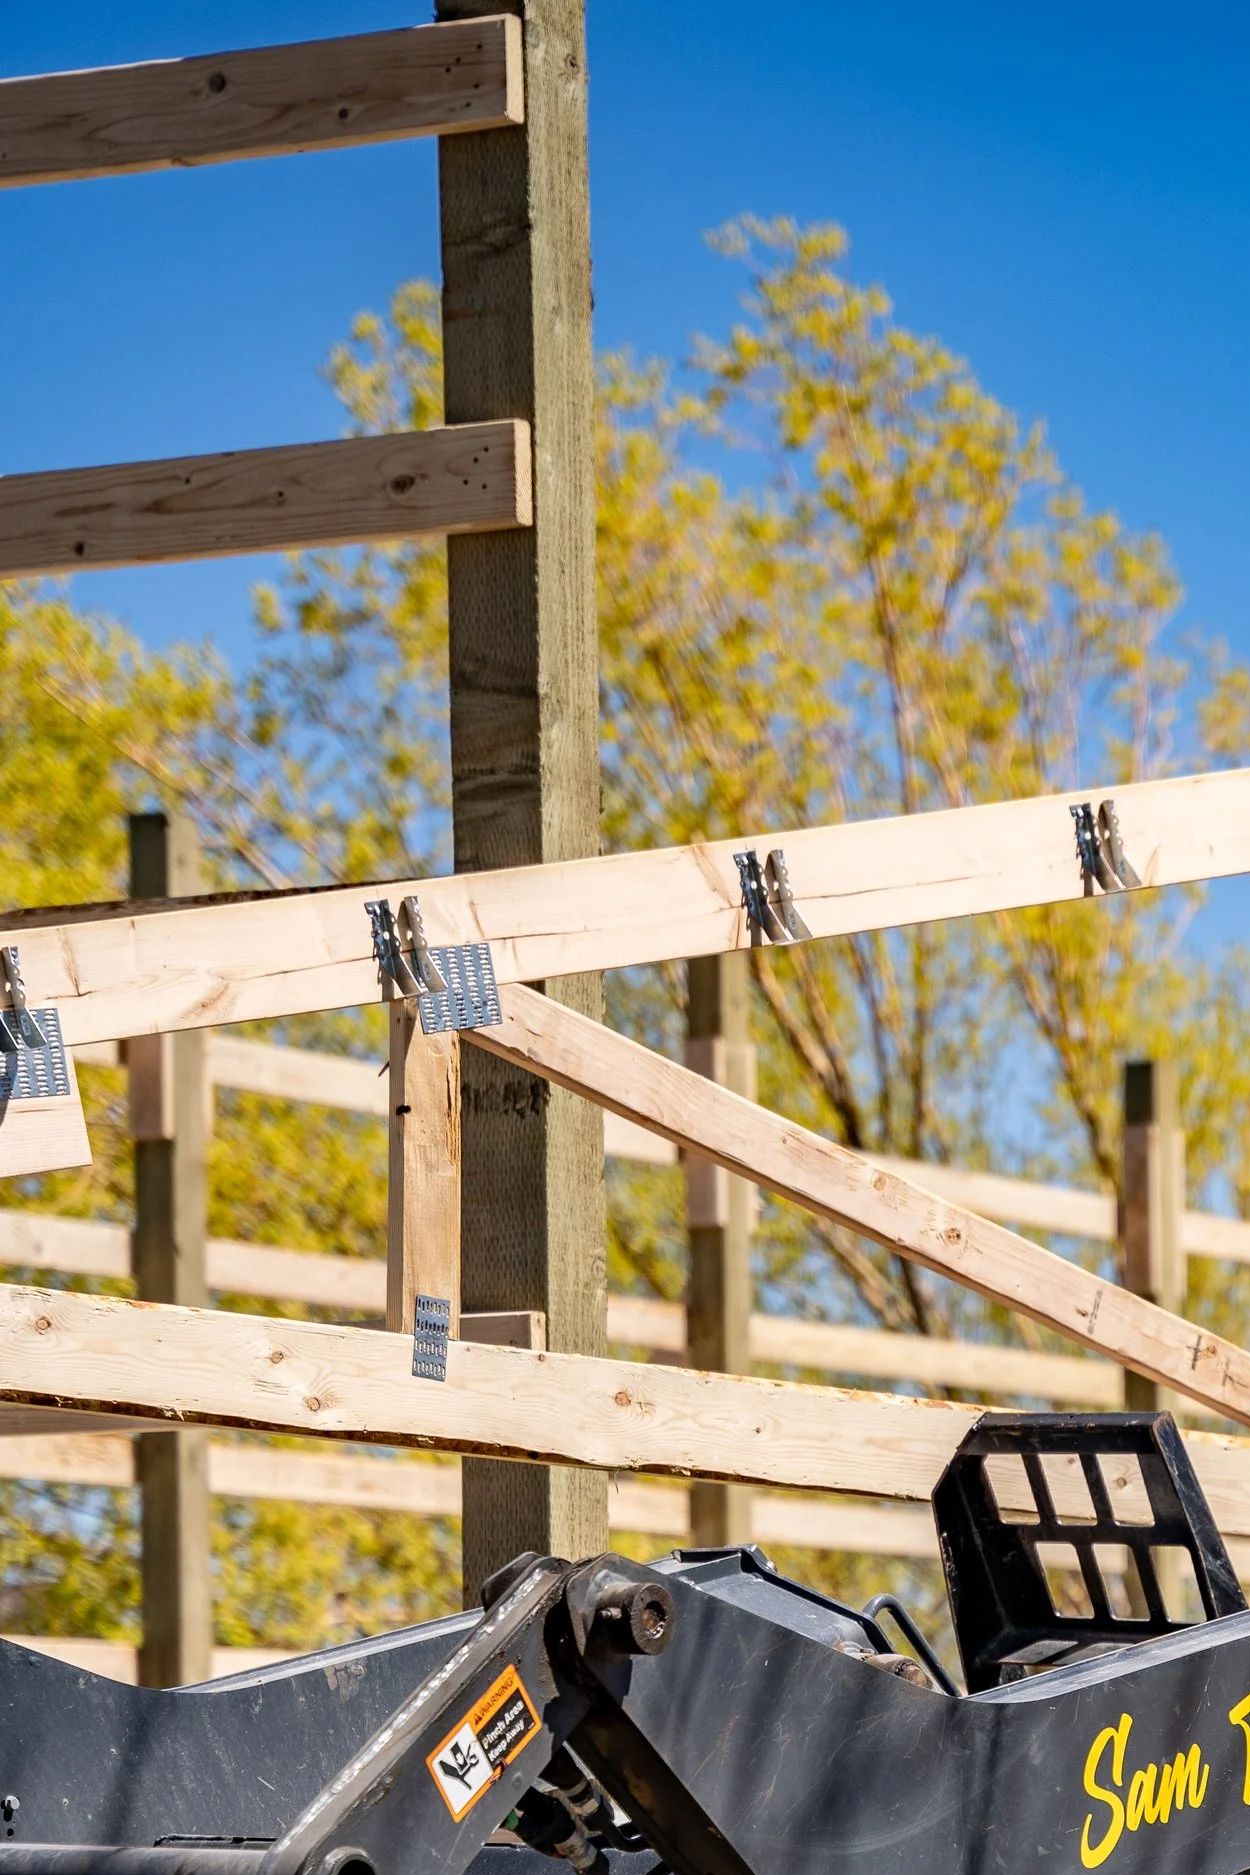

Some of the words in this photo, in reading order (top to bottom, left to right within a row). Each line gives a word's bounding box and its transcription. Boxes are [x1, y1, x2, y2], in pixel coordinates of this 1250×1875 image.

[480, 1676, 514, 1717] WARNING
[481, 1720, 505, 1750] Pinch
[504, 1700, 525, 1724] Area
[487, 1741, 508, 1762] Keep
[505, 1719, 526, 1743] Away
[1080, 1712, 1210, 1869] Sam
